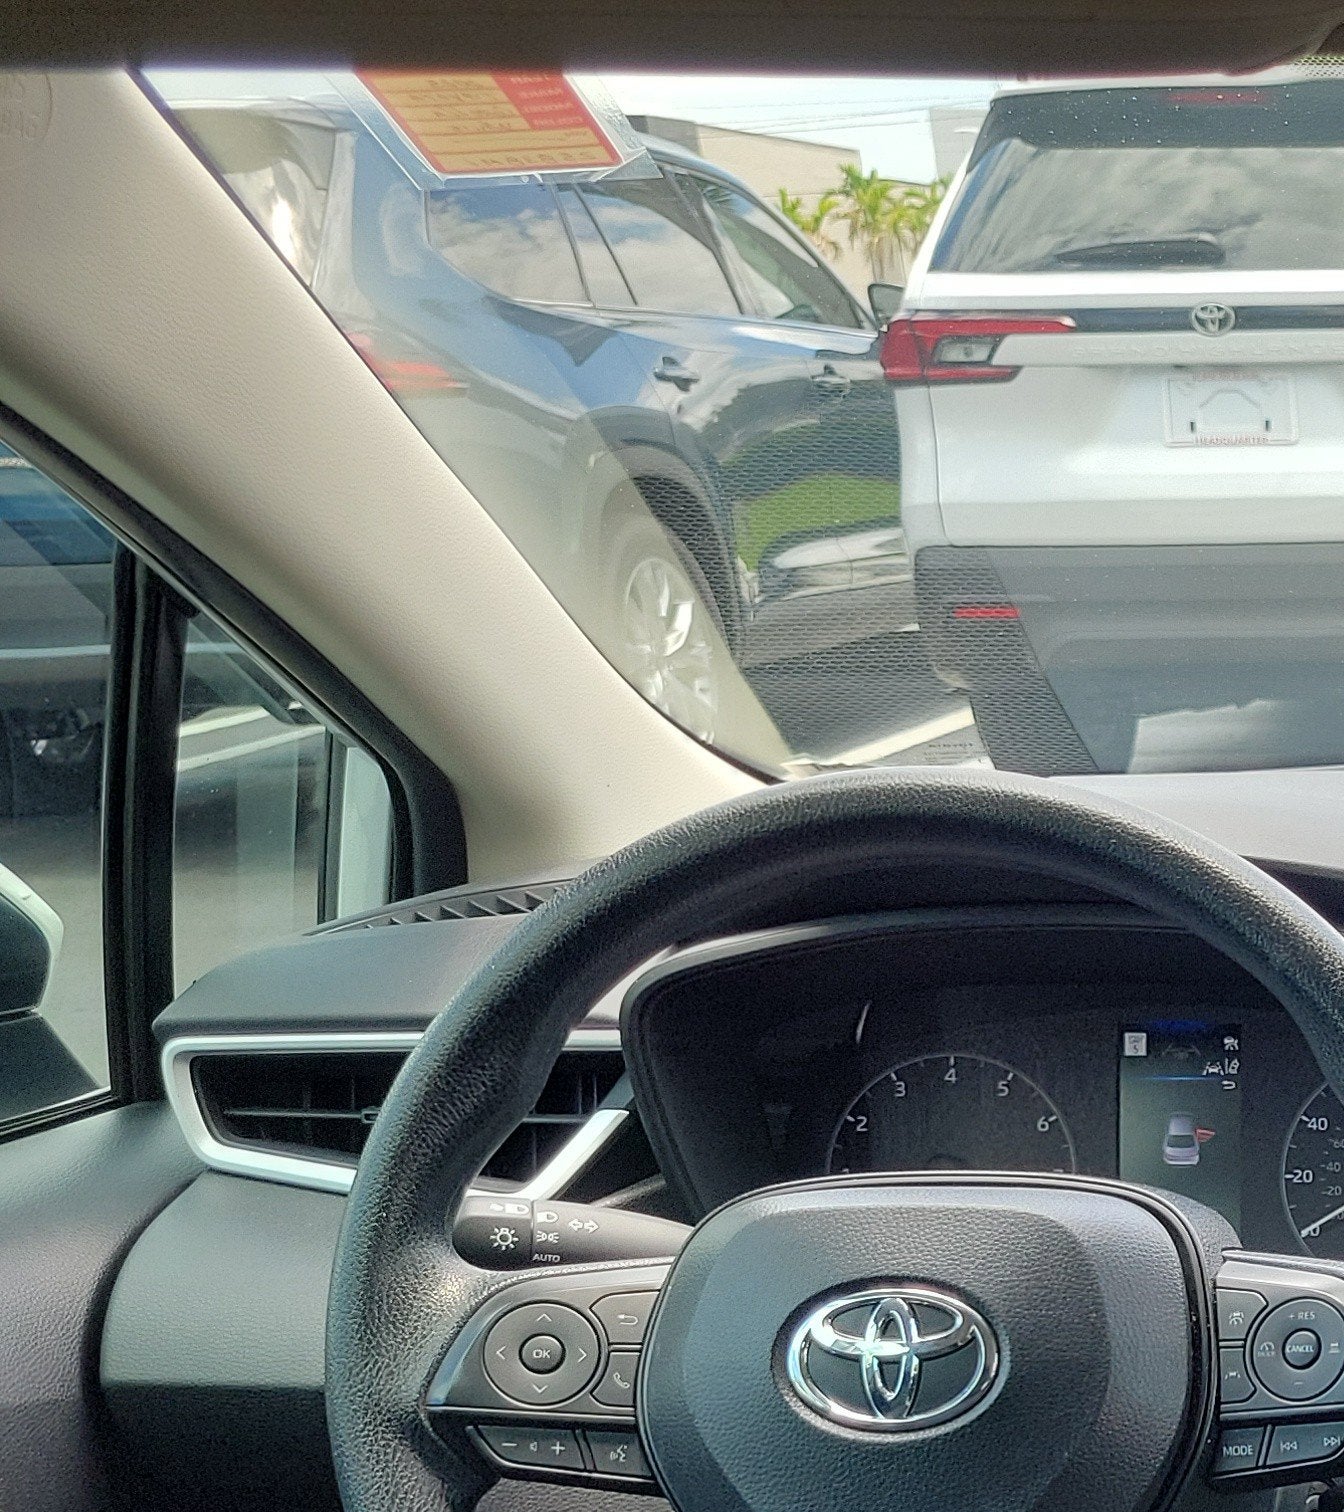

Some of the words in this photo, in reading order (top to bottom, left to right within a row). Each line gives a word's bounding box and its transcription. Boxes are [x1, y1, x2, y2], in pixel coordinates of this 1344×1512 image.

[943, 1068, 957, 1084] 4
[894, 1081, 906, 1097] 3
[997, 1081, 1009, 1097] 5
[855, 1115, 868, 1132] 2
[1036, 1116, 1050, 1132] 6
[1307, 1117, 1329, 1132] 40
[1326, 1162, 1342, 1172] 40
[1292, 1169, 1314, 1184] 20
[1327, 1186, 1342, 1196] 20
[532, 1253, 561, 1263] AUTO
[532, 1349, 551, 1359] OK
[1286, 1344, 1315, 1353] CANCEL
[1222, 1445, 1254, 1457] MODE
